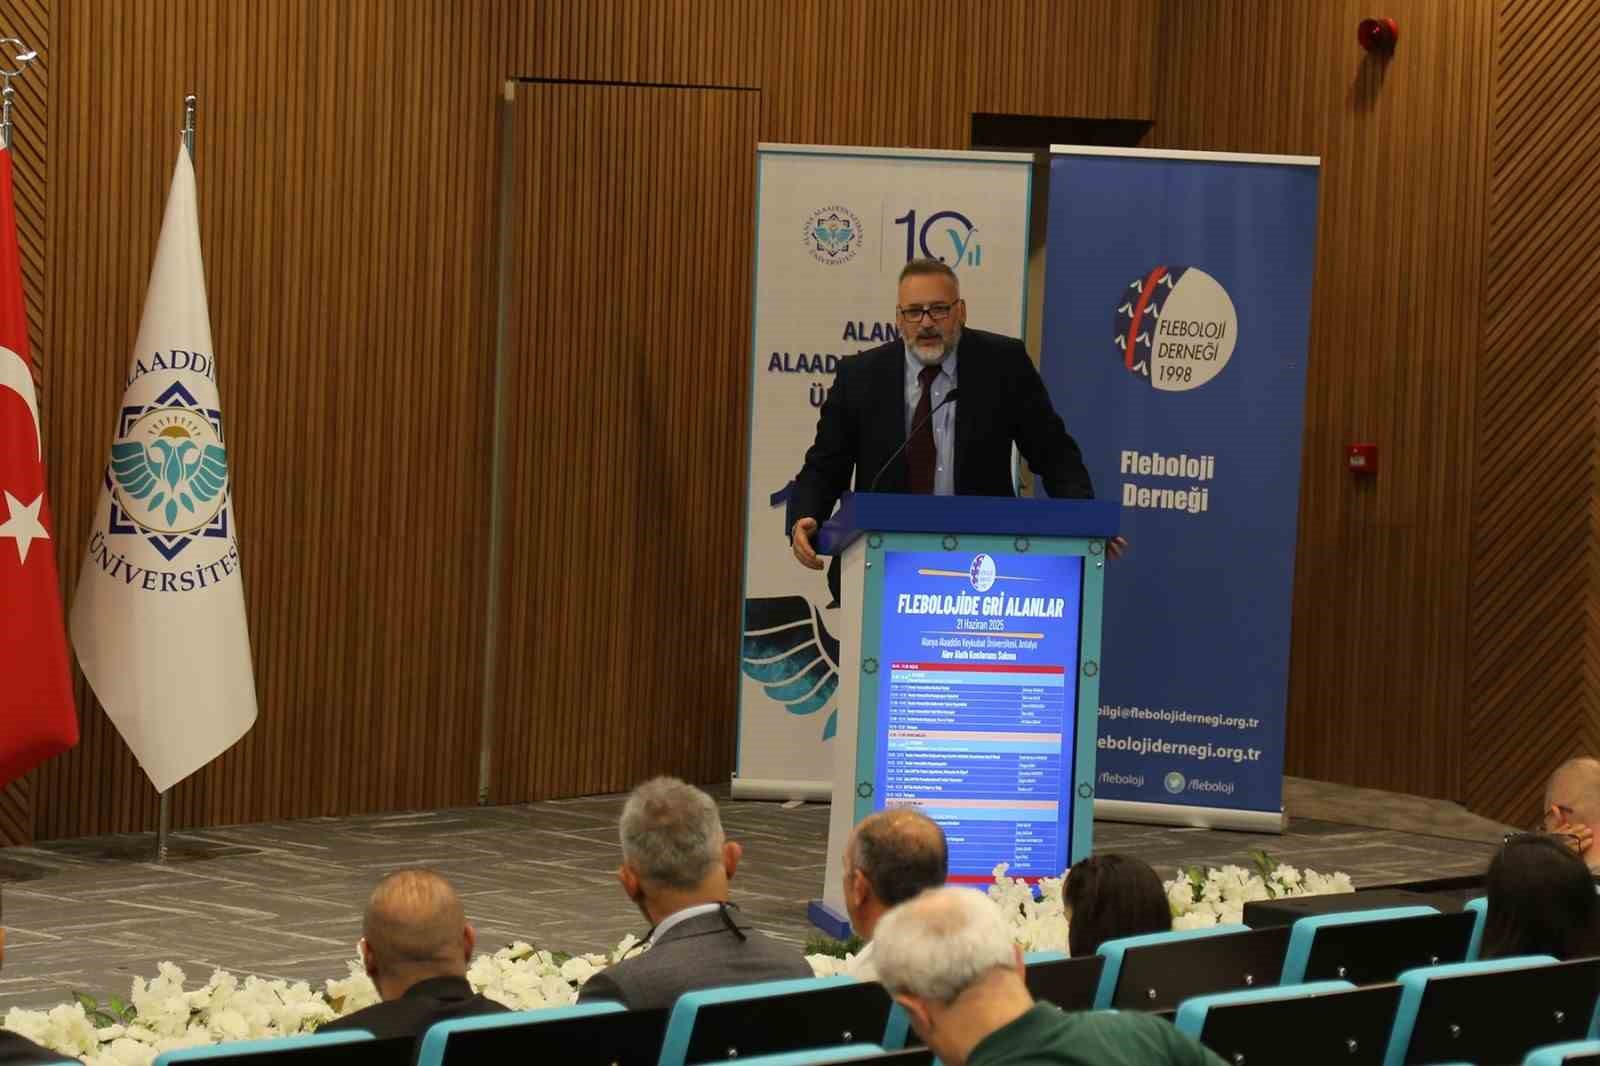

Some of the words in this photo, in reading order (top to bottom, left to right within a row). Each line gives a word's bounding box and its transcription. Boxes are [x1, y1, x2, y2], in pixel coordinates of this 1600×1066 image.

[842, 321, 900, 341] ALAN
[767, 352, 839, 373] ALAAD
[1158, 341, 1220, 361] DERNEĞİ
[1158, 365, 1192, 383] 1998
[1120, 450, 1214, 480] Fleboloji
[1122, 483, 1208, 514] Derneği
[898, 591, 979, 616] FLEBOLOJİDE
[983, 592, 1004, 616] GRİ
[1005, 597, 1065, 618] ALANLAR
[1097, 735, 1262, 762] ebolojidernegi.org.tr
